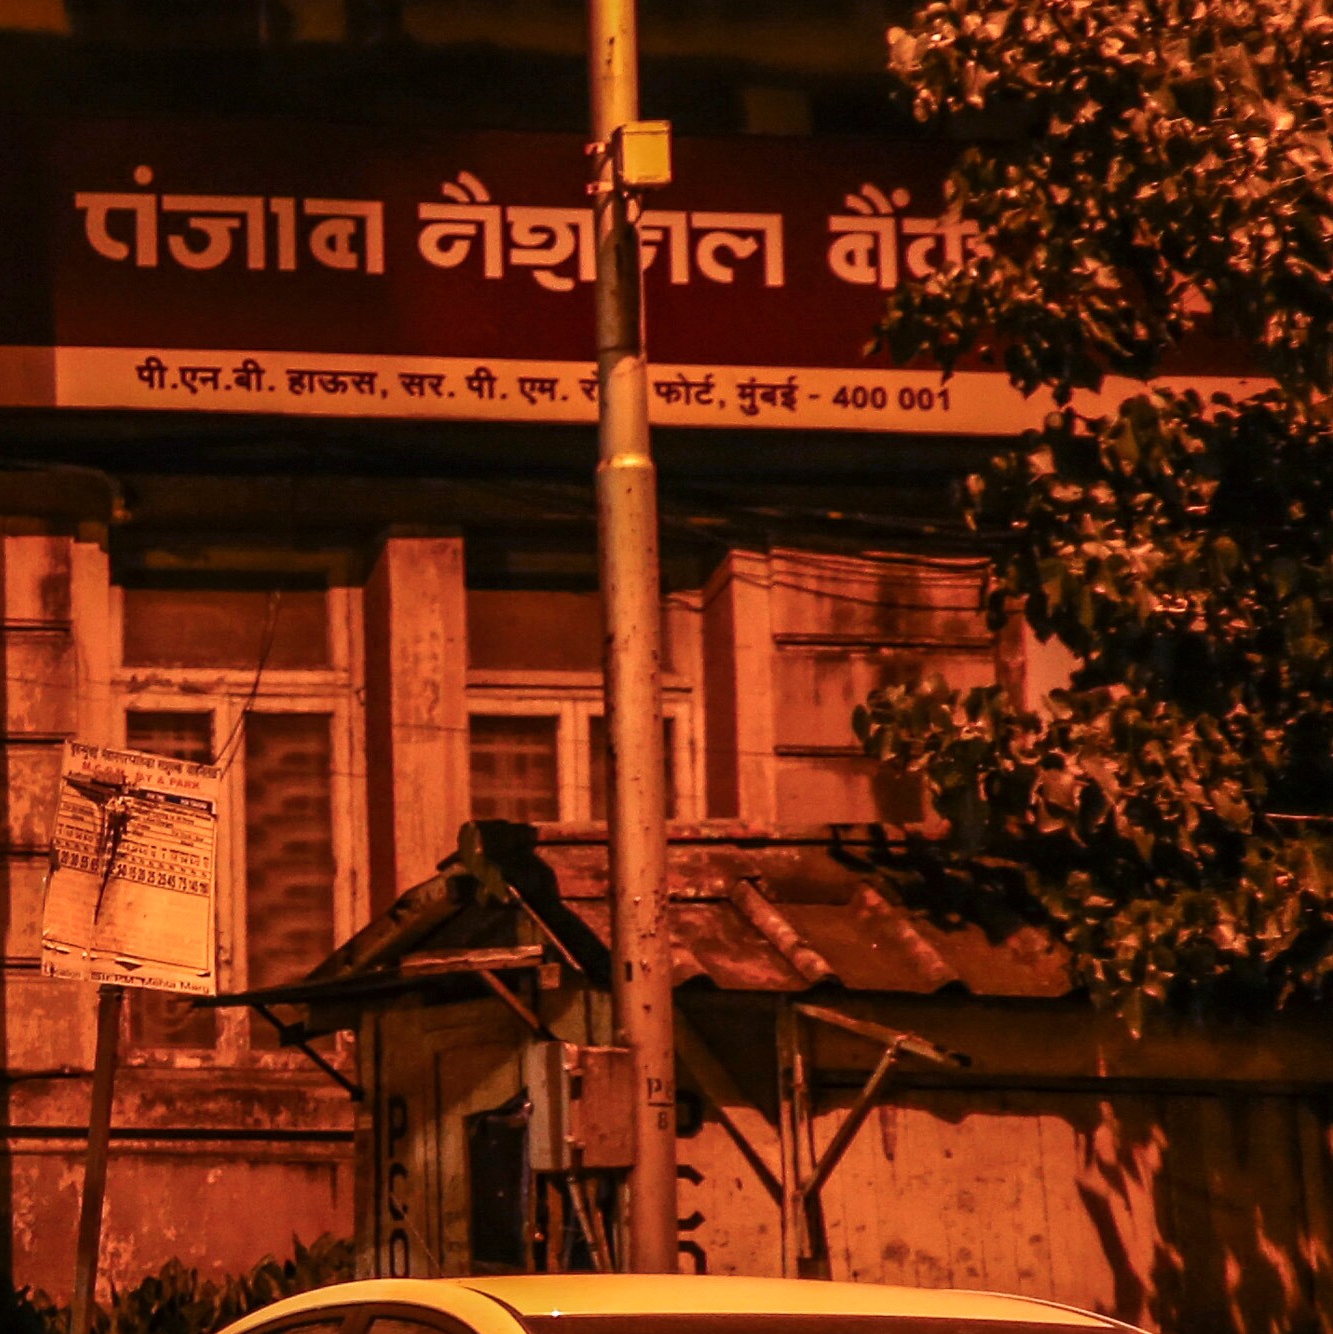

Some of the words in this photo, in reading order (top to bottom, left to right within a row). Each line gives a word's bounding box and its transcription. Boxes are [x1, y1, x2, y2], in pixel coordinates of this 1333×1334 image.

[75, 165, 384, 275] पंजाब
[737, 375, 798, 416] मुंबई
[832, 385, 888, 410] 400
[899, 386, 951, 412] 001
